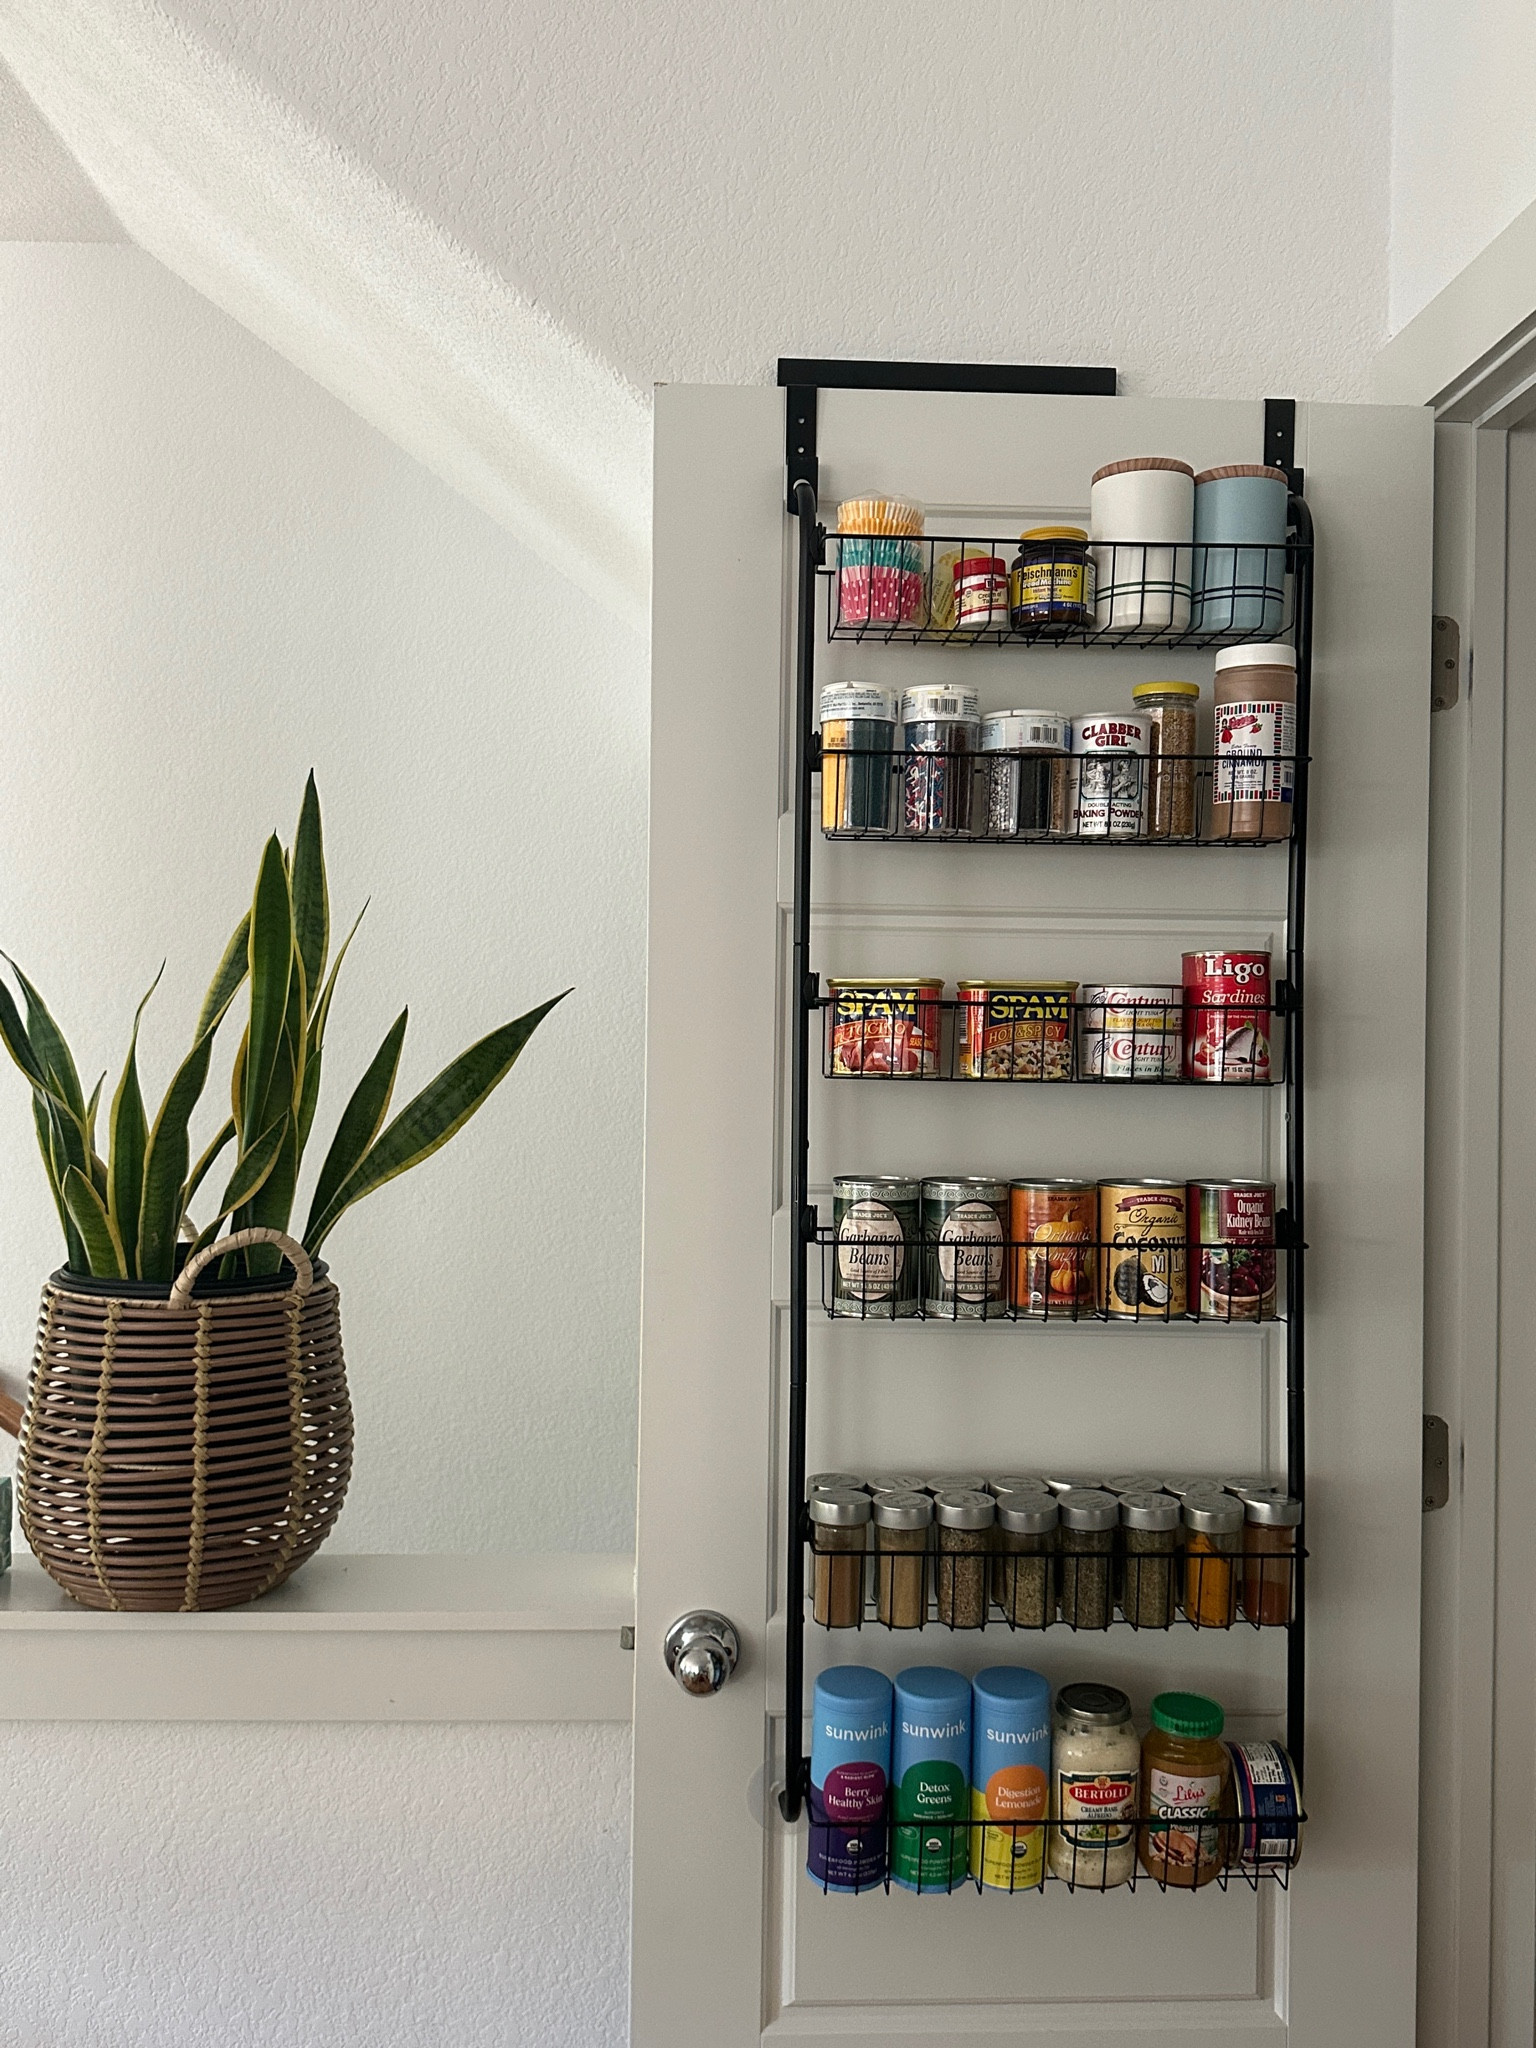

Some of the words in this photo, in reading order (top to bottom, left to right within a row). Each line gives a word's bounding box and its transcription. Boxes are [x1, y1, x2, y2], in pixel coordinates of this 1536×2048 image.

[1017, 566, 1078, 583] Feischmann's
[1081, 723, 1142, 741] CLABBER
[1095, 734, 1128, 748] GIRL
[1073, 809, 1106, 819] BAKING
[1109, 808, 1144, 820] POWDER
[1205, 958, 1265, 984] Ligo
[837, 992, 917, 1016] SPAM
[1107, 992, 1172, 1014] Century
[1202, 989, 1266, 1004] Sardines
[991, 995, 1069, 1019] SPAM
[1112, 1039, 1174, 1061] Century
[1237, 1199, 1264, 1215] Organic
[1128, 1207, 1178, 1237] Organic
[1226, 1213, 1253, 1230] Kidney
[841, 1228, 901, 1247] Garbanzo
[1034, 1223, 1092, 1245] Organic
[849, 1247, 890, 1265] Beans
[954, 1249, 994, 1266] Beans
[825, 1721, 888, 1741] sunwink
[902, 1720, 966, 1739] sunwink
[986, 1724, 1048, 1744] sunwink
[845, 1787, 870, 1797] Berry
[920, 1782, 950, 1793] Detox
[998, 1787, 1042, 1799] Digestion
[1075, 1787, 1128, 1799] BERTOLLI
[828, 1795, 864, 1809] Healthy
[866, 1795, 883, 1806] Skin
[917, 1793, 952, 1804] Greens
[995, 1797, 1042, 1808] Lemonade
[1160, 1806, 1209, 1819] CLASSIC
